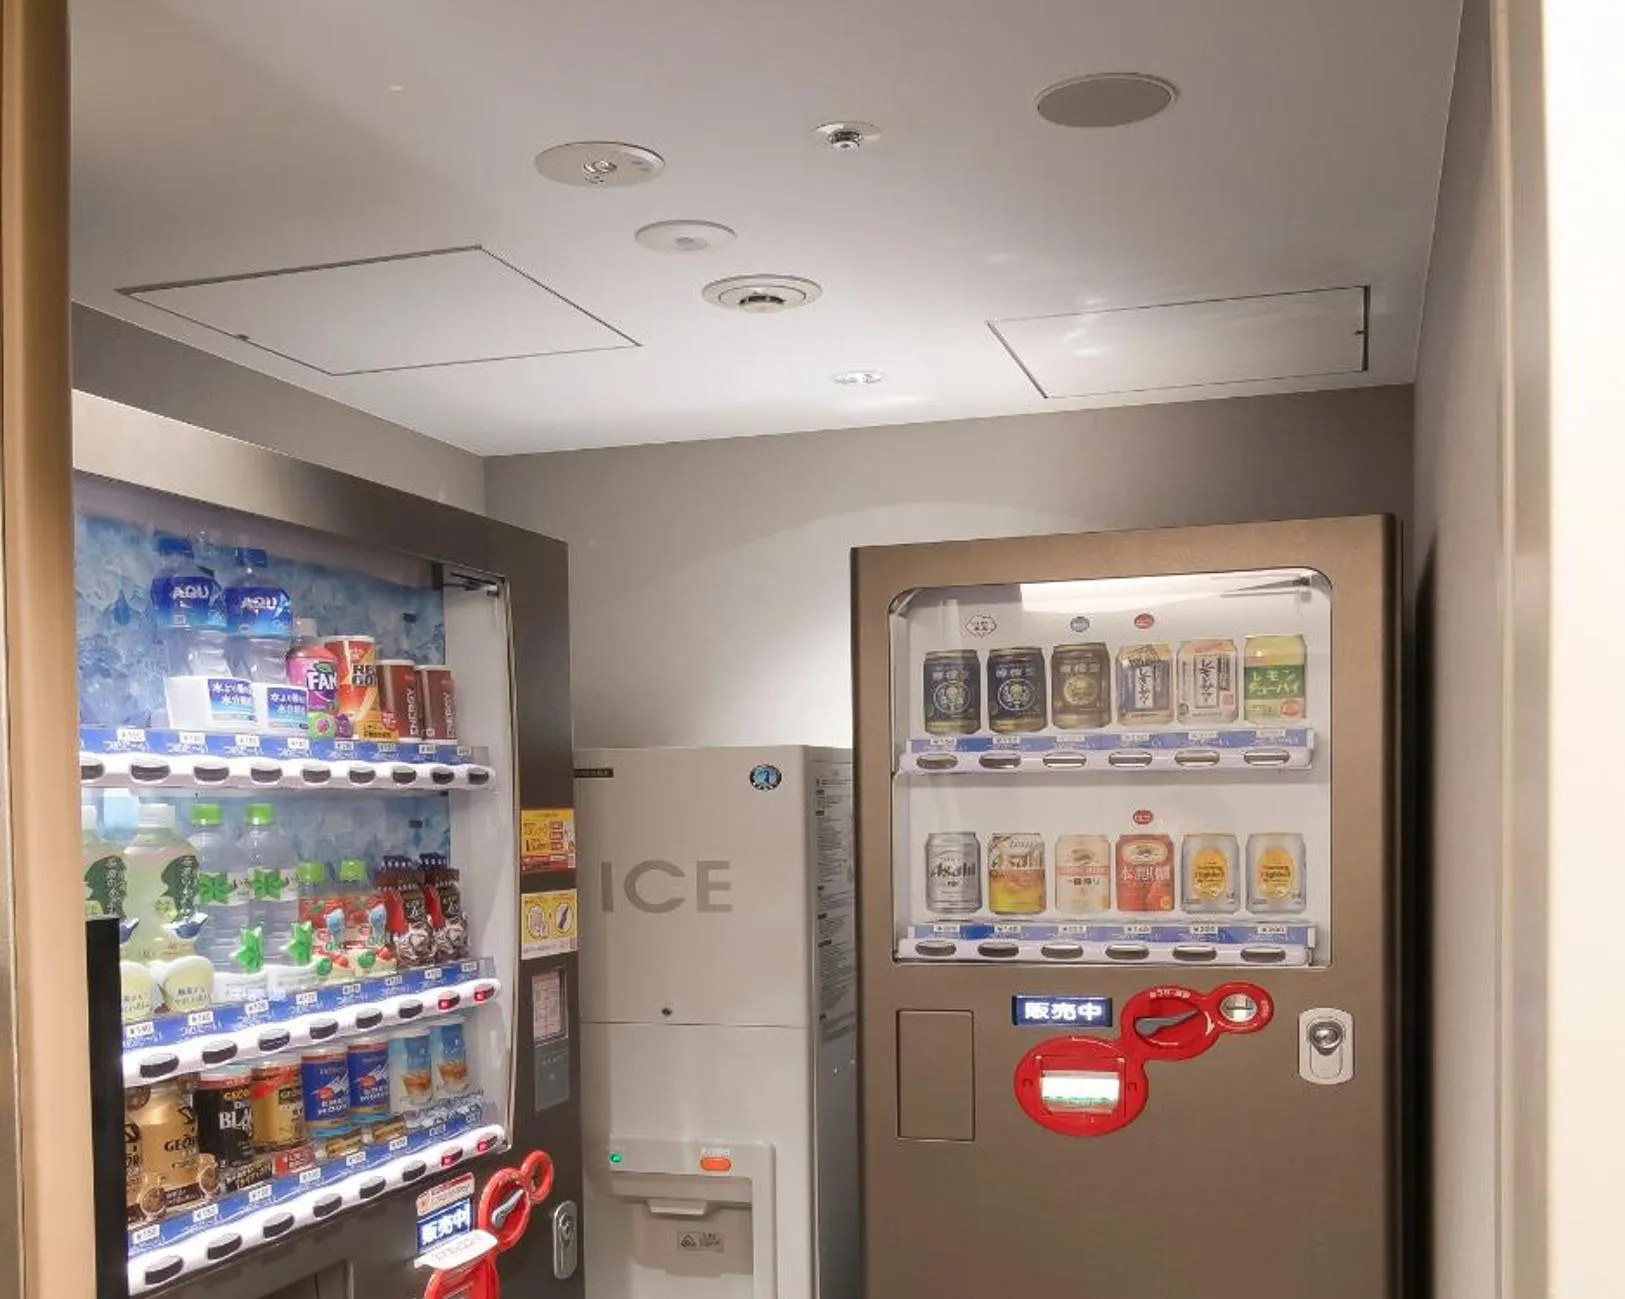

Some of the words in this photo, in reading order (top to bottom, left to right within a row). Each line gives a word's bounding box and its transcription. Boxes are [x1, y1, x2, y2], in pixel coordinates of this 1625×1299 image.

[600, 860, 733, 913] ICE
[1024, 1001, 1102, 1022] 販売中
